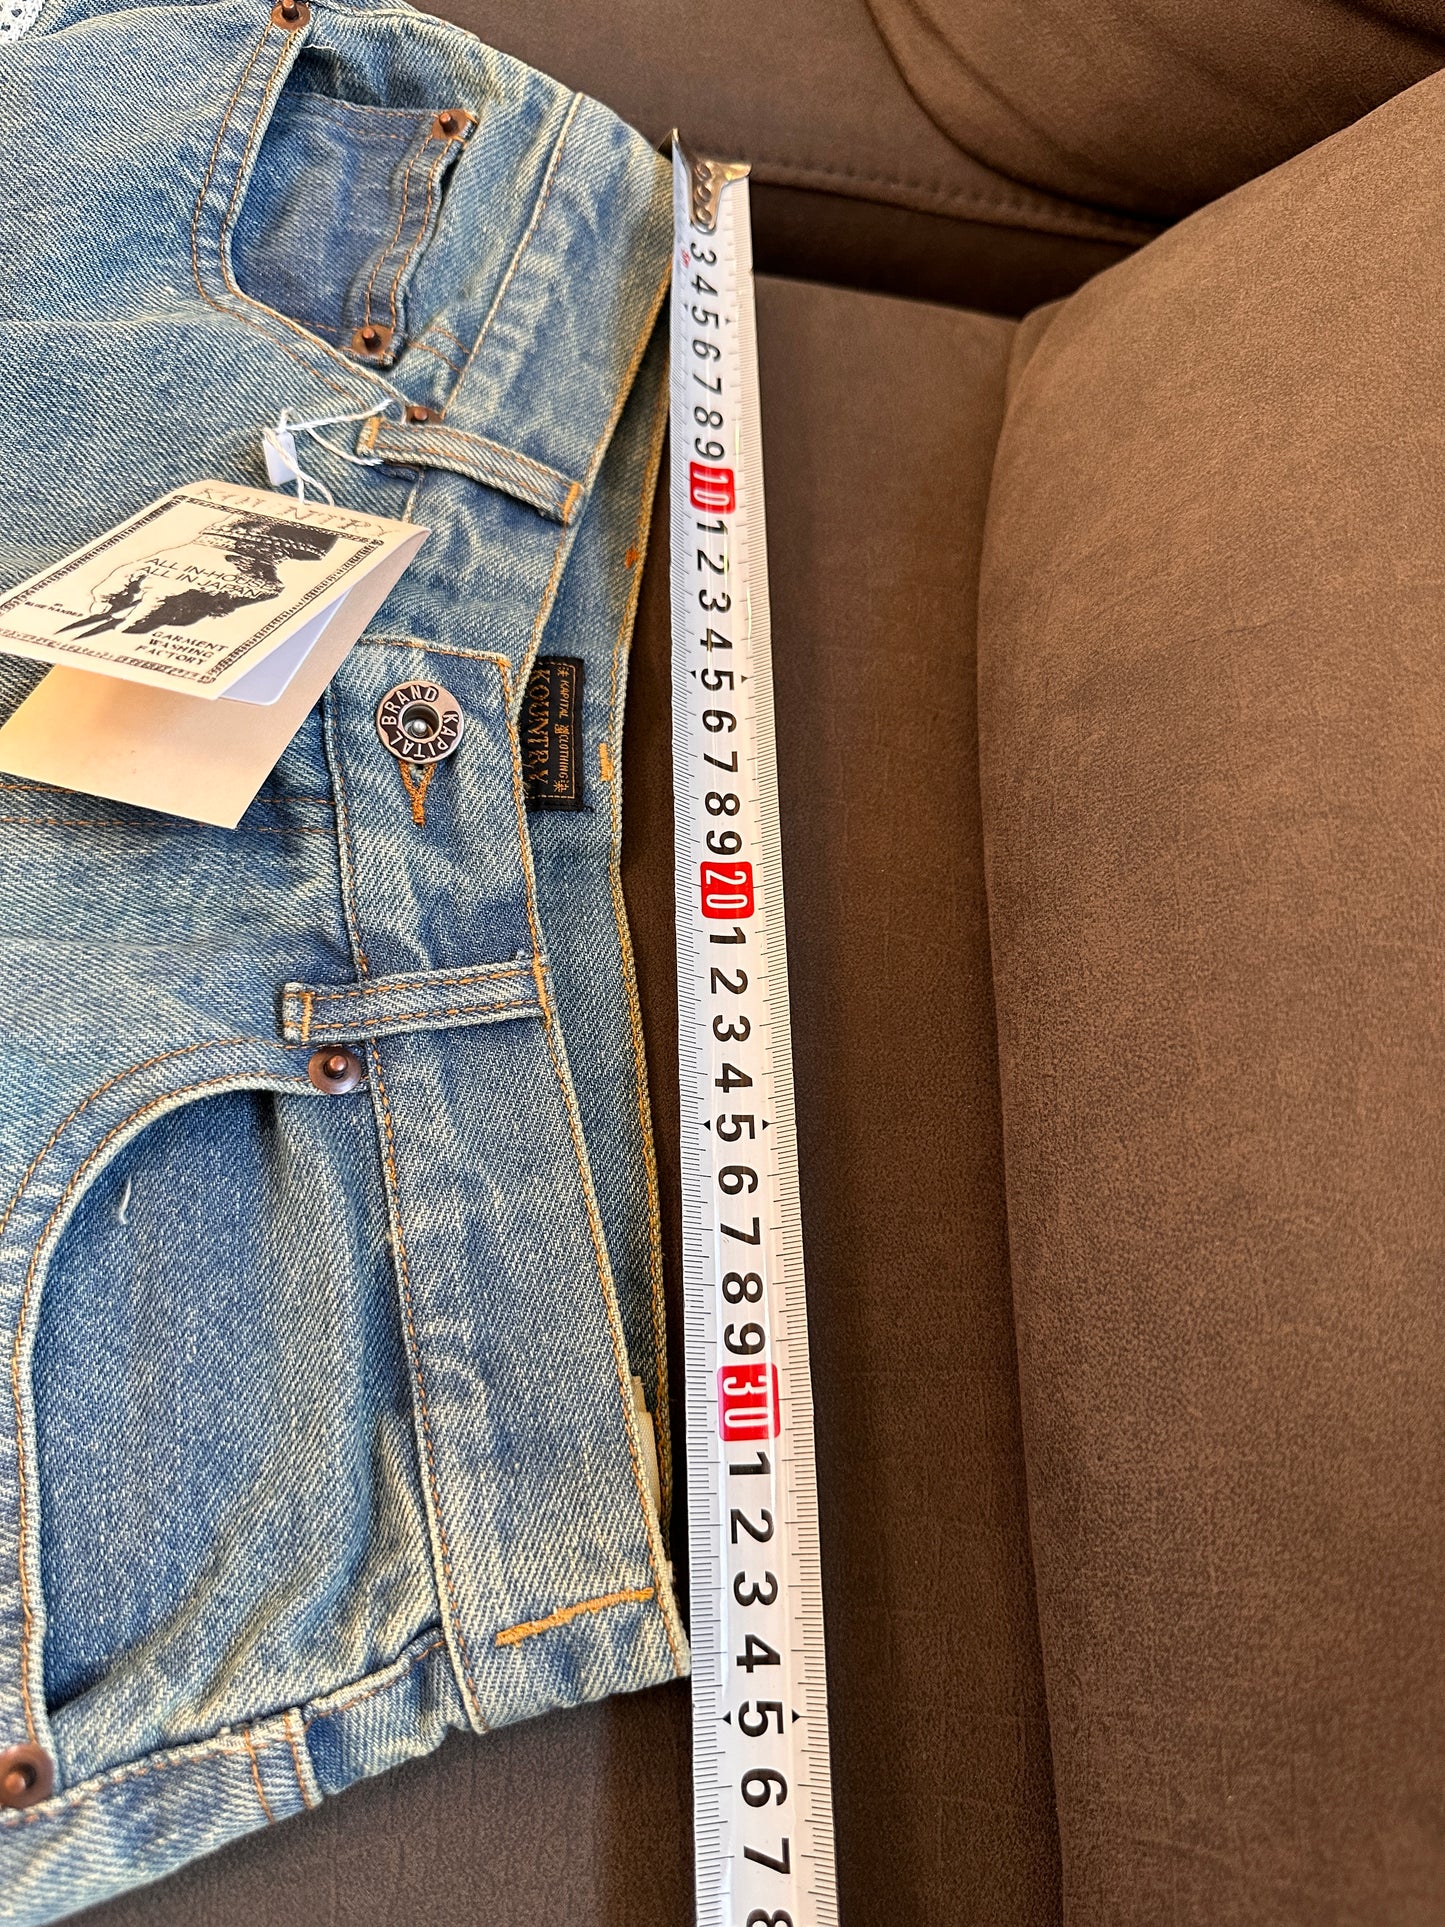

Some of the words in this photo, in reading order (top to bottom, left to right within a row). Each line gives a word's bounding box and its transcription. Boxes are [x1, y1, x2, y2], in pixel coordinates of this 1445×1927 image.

[691, 243, 717, 266] 3
[691, 275, 718, 297] 4
[692, 306, 720, 328] 5
[692, 338, 721, 362] 6
[692, 371, 722, 395] 7
[694, 406, 724, 430] 8
[695, 437, 725, 461] 9
[693, 472, 730, 506] 10
[697, 519, 727, 534] 1
[141, 566, 174, 578] ALL
[176, 573, 198, 584] IN
[145, 558, 178, 570] ALL
[697, 549, 730, 575] 2
[699, 588, 731, 613] 3
[149, 639, 214, 659] WASHING
[152, 631, 228, 651] GARMENT
[700, 628, 732, 652] 4
[135, 645, 211, 666] FACTORY
[701, 667, 734, 691] 5
[381, 685, 437, 725] BRAND
[559, 679, 570, 718] KAPITAL
[528, 669, 550, 784] KOUNTRY
[702, 709, 737, 734] 6
[391, 714, 459, 758] KAPITAL
[559, 734, 569, 779] CLOTHING
[704, 751, 738, 773] 7
[705, 791, 740, 817] 8
[706, 830, 742, 855] 9
[705, 870, 747, 908] 20
[710, 926, 746, 944] 1
[710, 967, 748, 995] 2
[713, 1014, 751, 1042] 3
[715, 1062, 752, 1093] 4
[717, 1114, 756, 1142] 5
[719, 1166, 758, 1195] 6
[720, 1217, 761, 1246] 7
[722, 1272, 763, 1304] 8
[724, 1323, 765, 1355] 9
[722, 1376, 773, 1427] 30
[729, 1451, 770, 1476] 1
[731, 1508, 773, 1544] 2
[734, 1571, 778, 1607] 3
[736, 1633, 780, 1673] 4
[738, 1700, 784, 1737] 5
[741, 1768, 787, 1808] 6
[743, 1837, 790, 1875] 7
